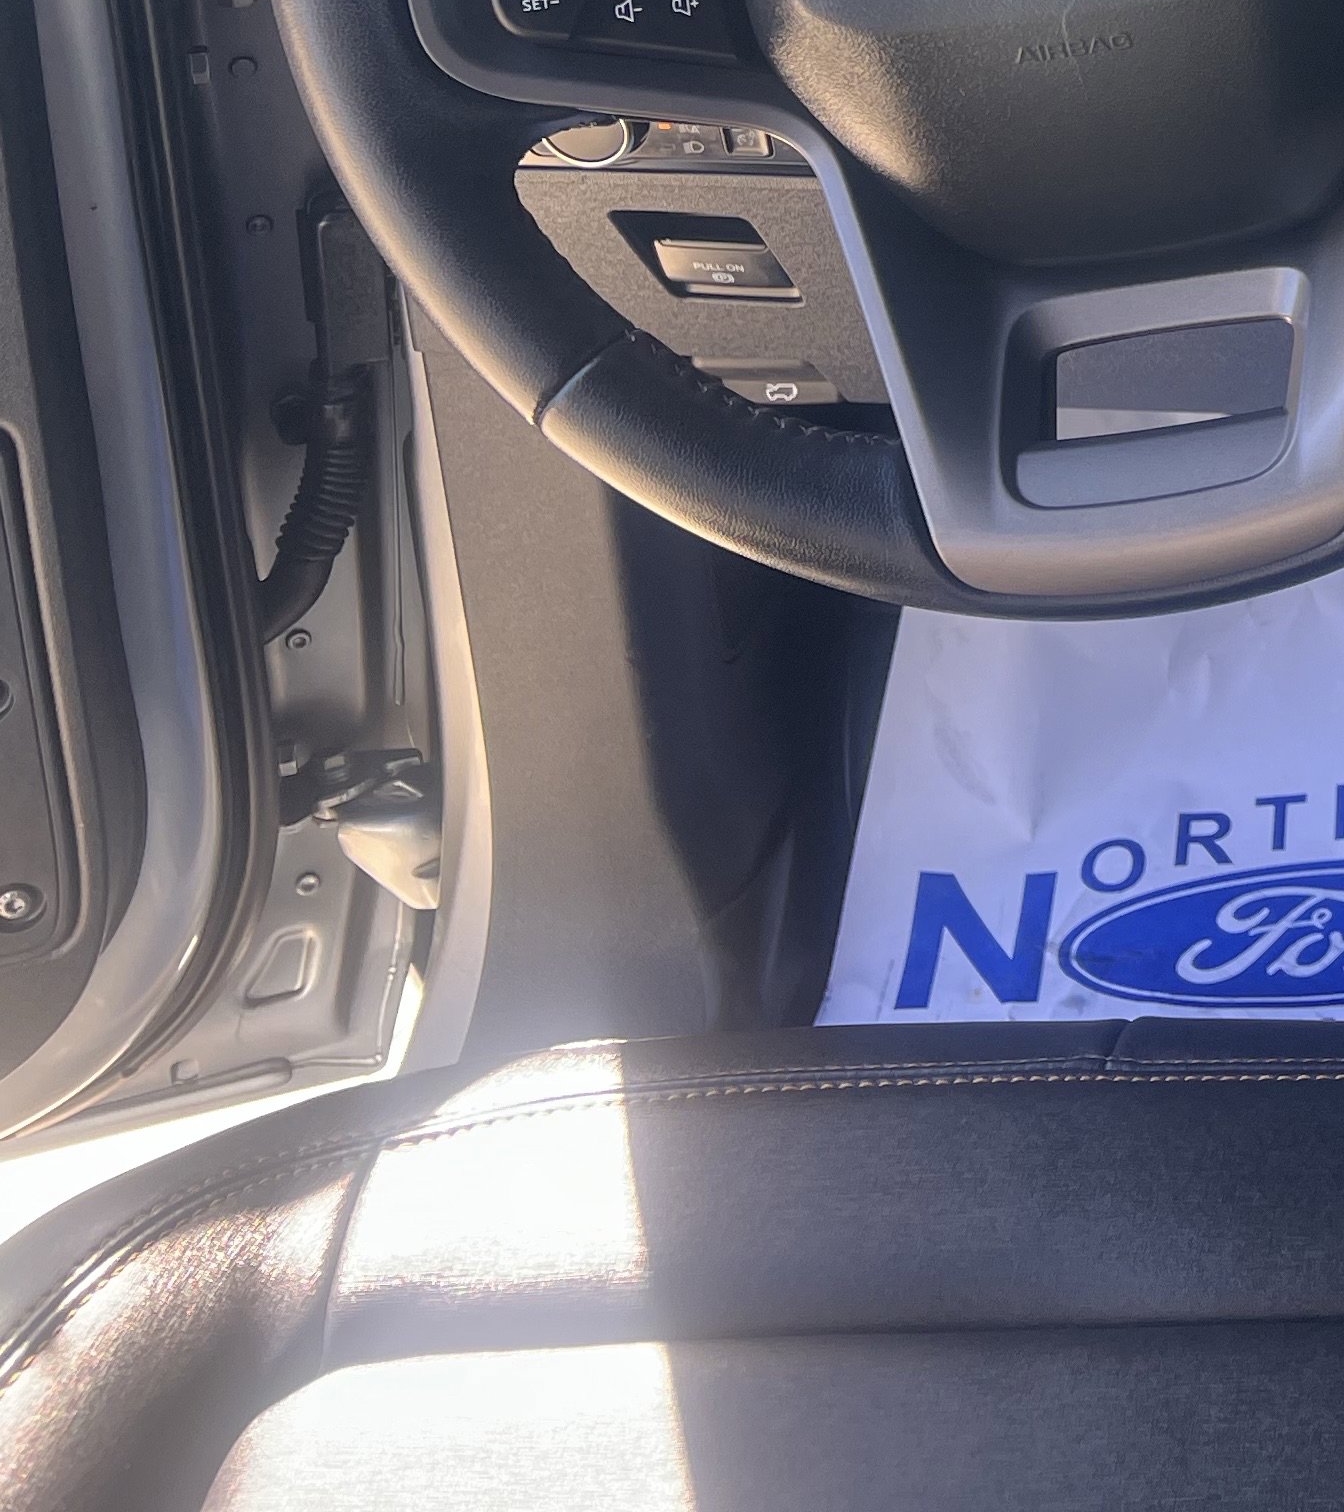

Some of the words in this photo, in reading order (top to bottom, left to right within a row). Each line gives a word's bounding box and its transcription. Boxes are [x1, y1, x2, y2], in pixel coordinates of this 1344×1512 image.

[1014, 33, 1134, 65] AIRBAG
[692, 261, 721, 273] PULL
[725, 262, 745, 274] ON
